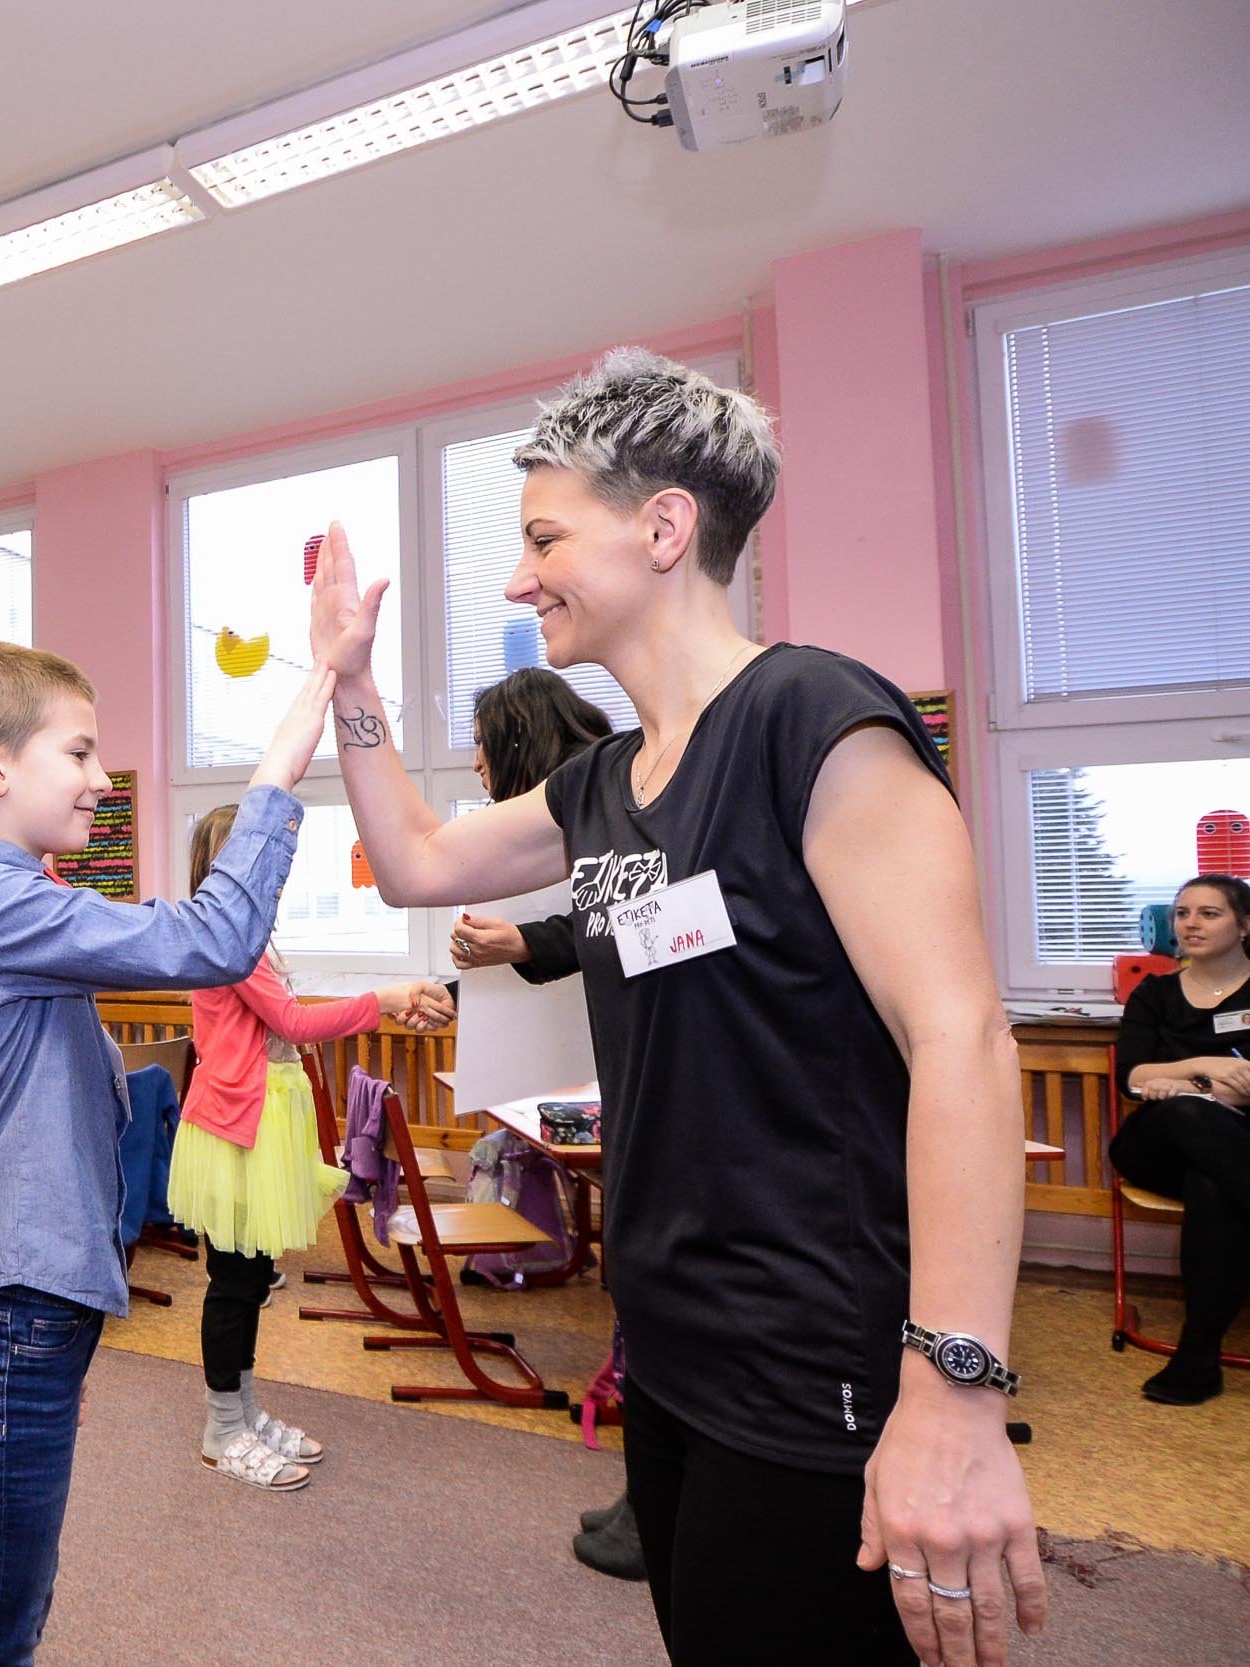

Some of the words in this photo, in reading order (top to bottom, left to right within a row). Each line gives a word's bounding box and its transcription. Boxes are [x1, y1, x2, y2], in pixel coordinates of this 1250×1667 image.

[586, 911, 607, 938] PRO
[616, 900, 662, 927] ETIKETA
[669, 929, 706, 953] JANA
[841, 1383, 857, 1431] DOMYOS
